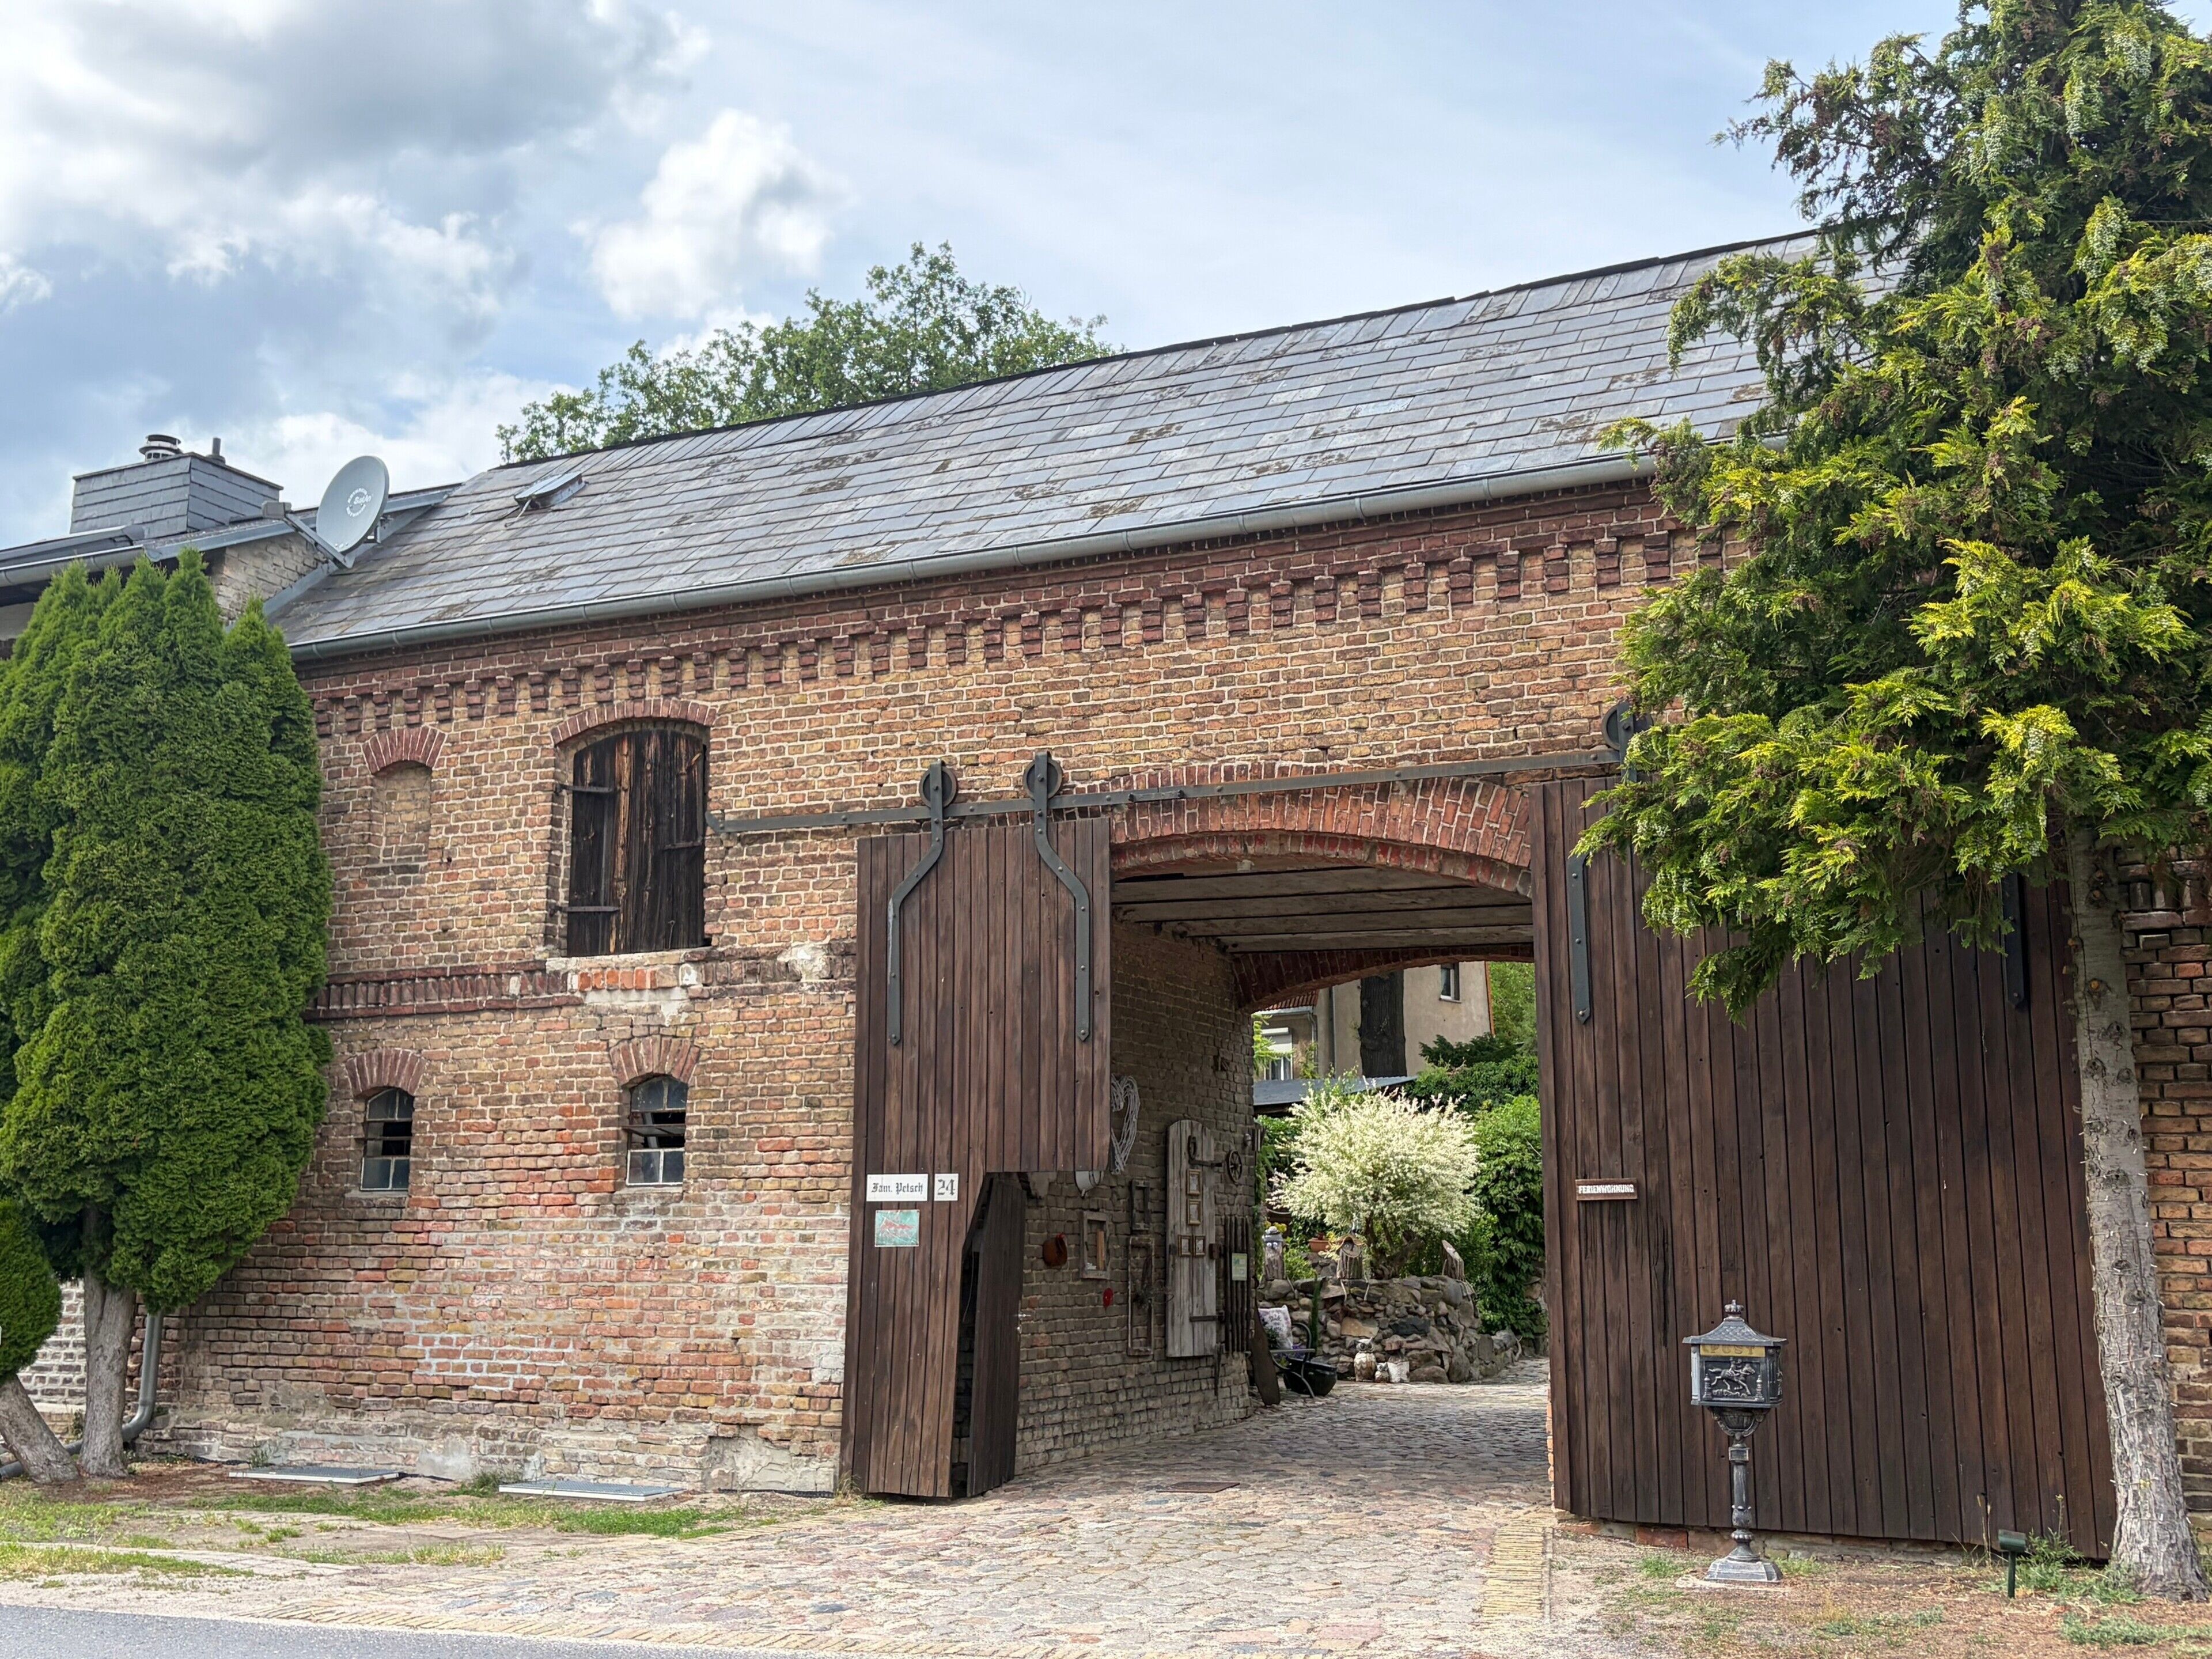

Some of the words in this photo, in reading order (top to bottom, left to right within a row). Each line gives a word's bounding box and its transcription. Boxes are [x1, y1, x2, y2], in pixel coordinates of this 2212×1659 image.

[872, 1183, 892, 1193] Fam.
[896, 1182, 923, 1195] Petsch
[937, 1179, 956, 1196] 24
[1578, 1184, 1634, 1194] FERIENWOHNUNG
[1710, 1345, 1755, 1354] POST
